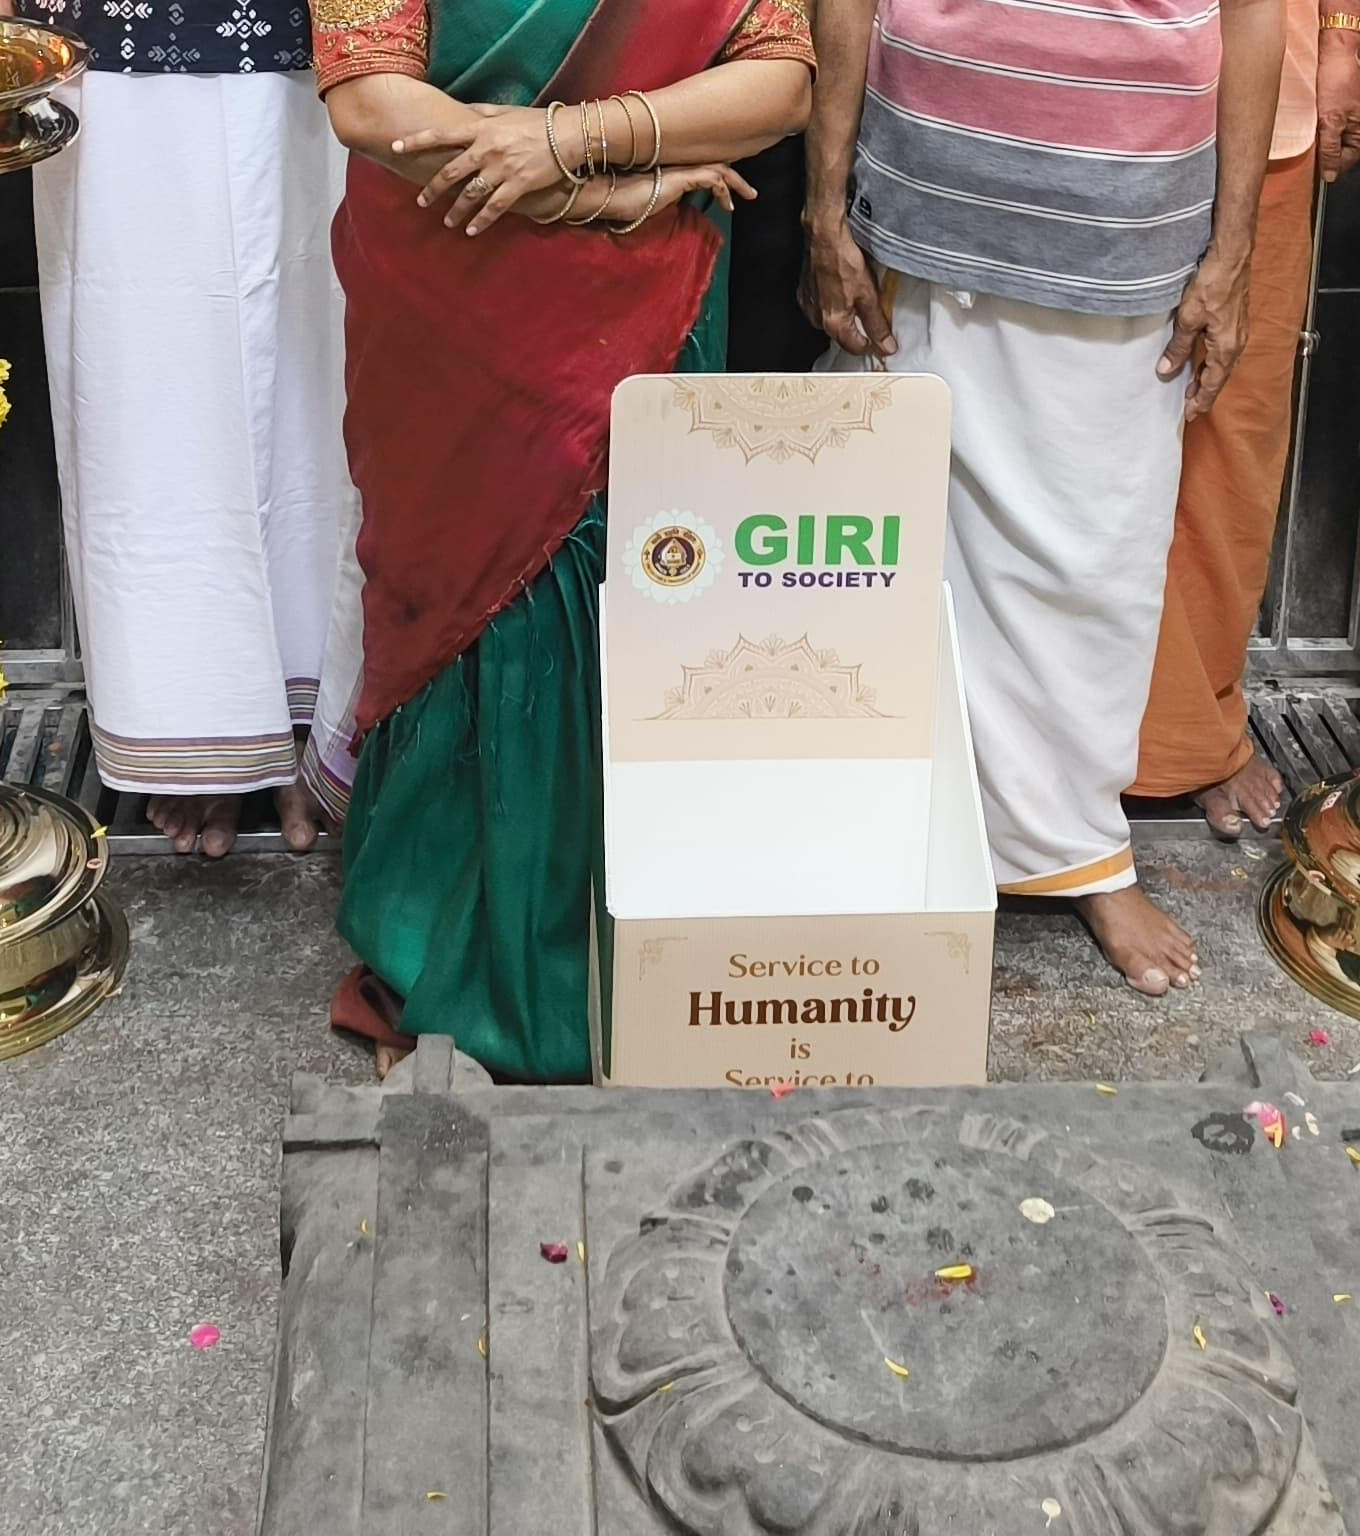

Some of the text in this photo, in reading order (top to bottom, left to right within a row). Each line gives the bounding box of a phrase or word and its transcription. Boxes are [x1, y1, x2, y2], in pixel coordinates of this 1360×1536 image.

[734, 514, 900, 566] GIRI
[738, 572, 896, 588] TO SOCIETY
[728, 953, 880, 978] Service to
[688, 987, 916, 1032] Humanity
[790, 1037, 811, 1060] is
